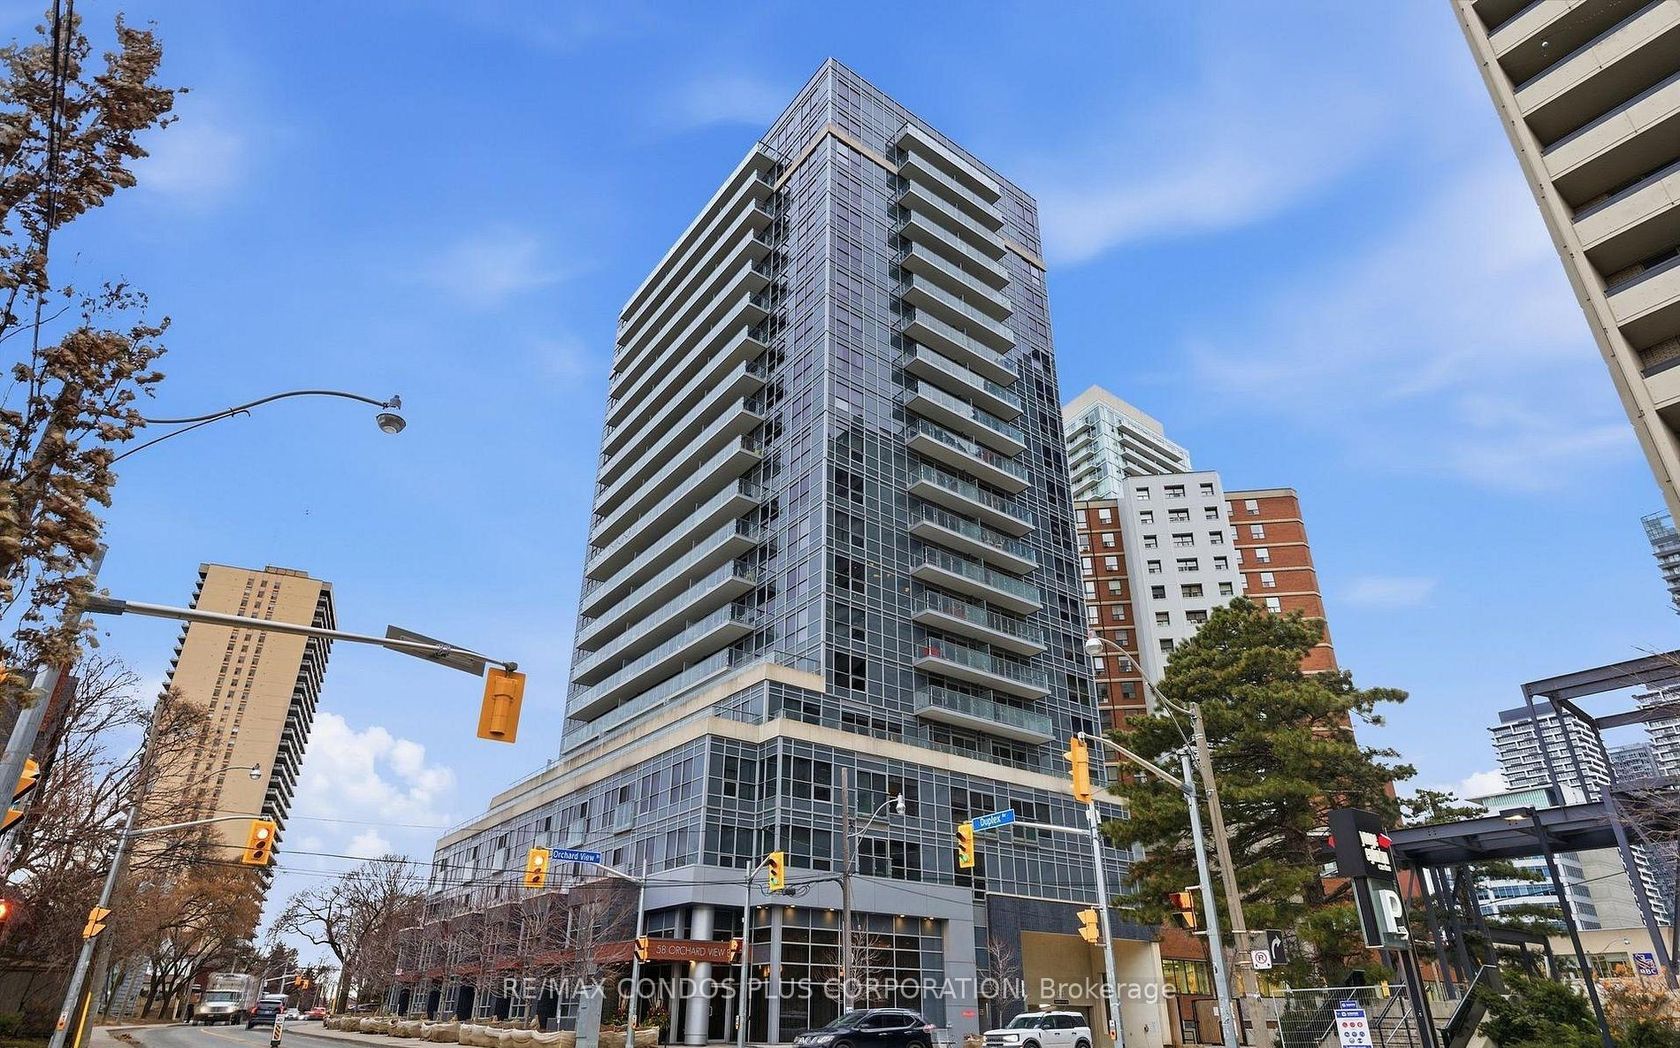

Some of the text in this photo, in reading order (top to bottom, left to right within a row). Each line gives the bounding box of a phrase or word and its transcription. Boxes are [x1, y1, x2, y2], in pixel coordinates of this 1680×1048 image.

[980, 815, 1001, 827] Duplex
[553, 851, 579, 860] Orchard
[580, 853, 595, 861] View
[1379, 889, 1402, 933] P
[668, 946, 706, 956] ORCHARD
[707, 948, 726, 957] VIEW
